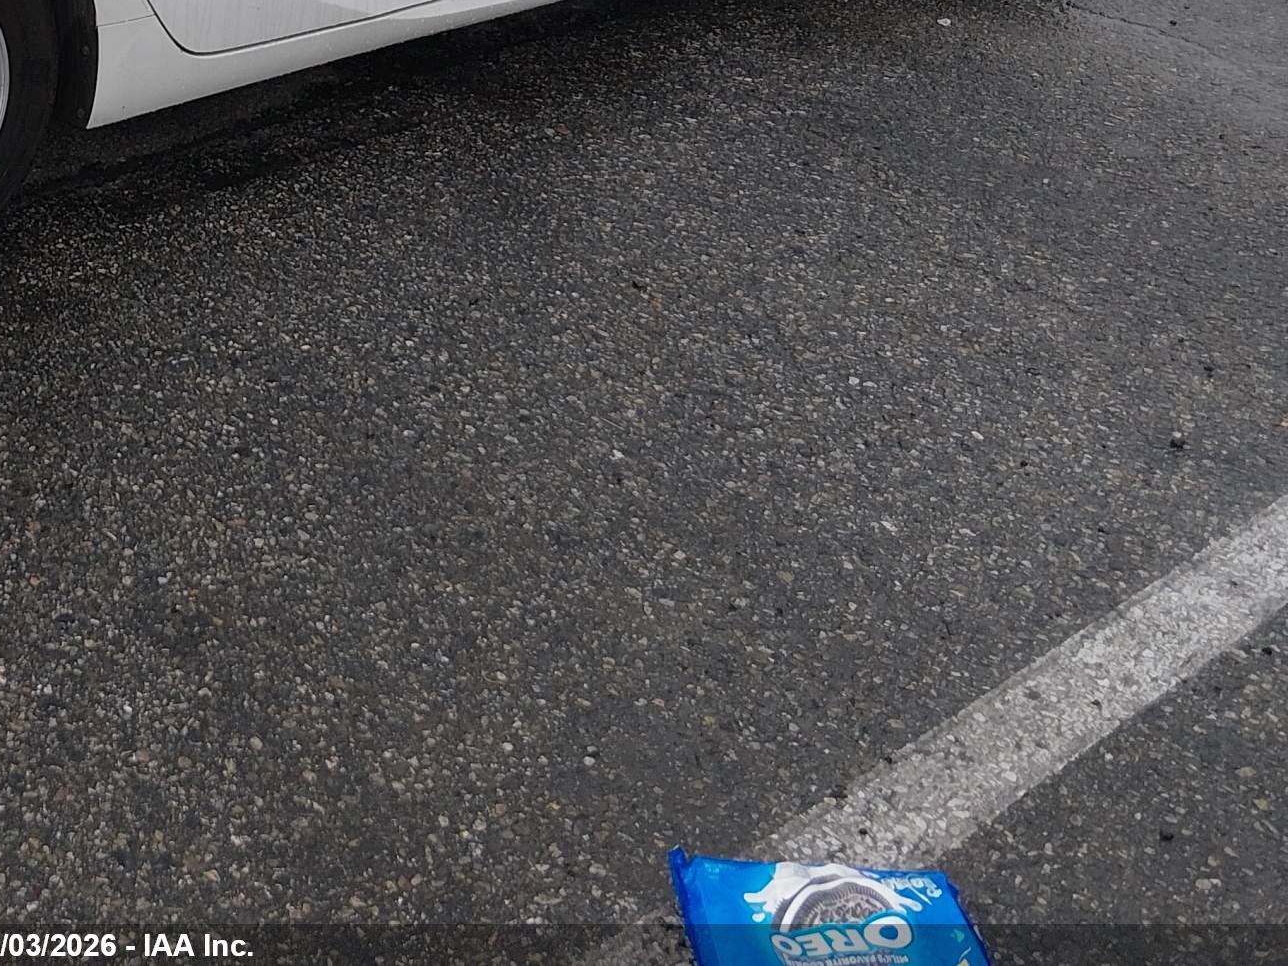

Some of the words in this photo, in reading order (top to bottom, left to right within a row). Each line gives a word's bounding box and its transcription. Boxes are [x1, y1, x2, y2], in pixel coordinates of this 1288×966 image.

[771, 916, 913, 956] OREO
[825, 955, 876, 966] FAVORITE
[877, 954, 909, 964] MILK'S
